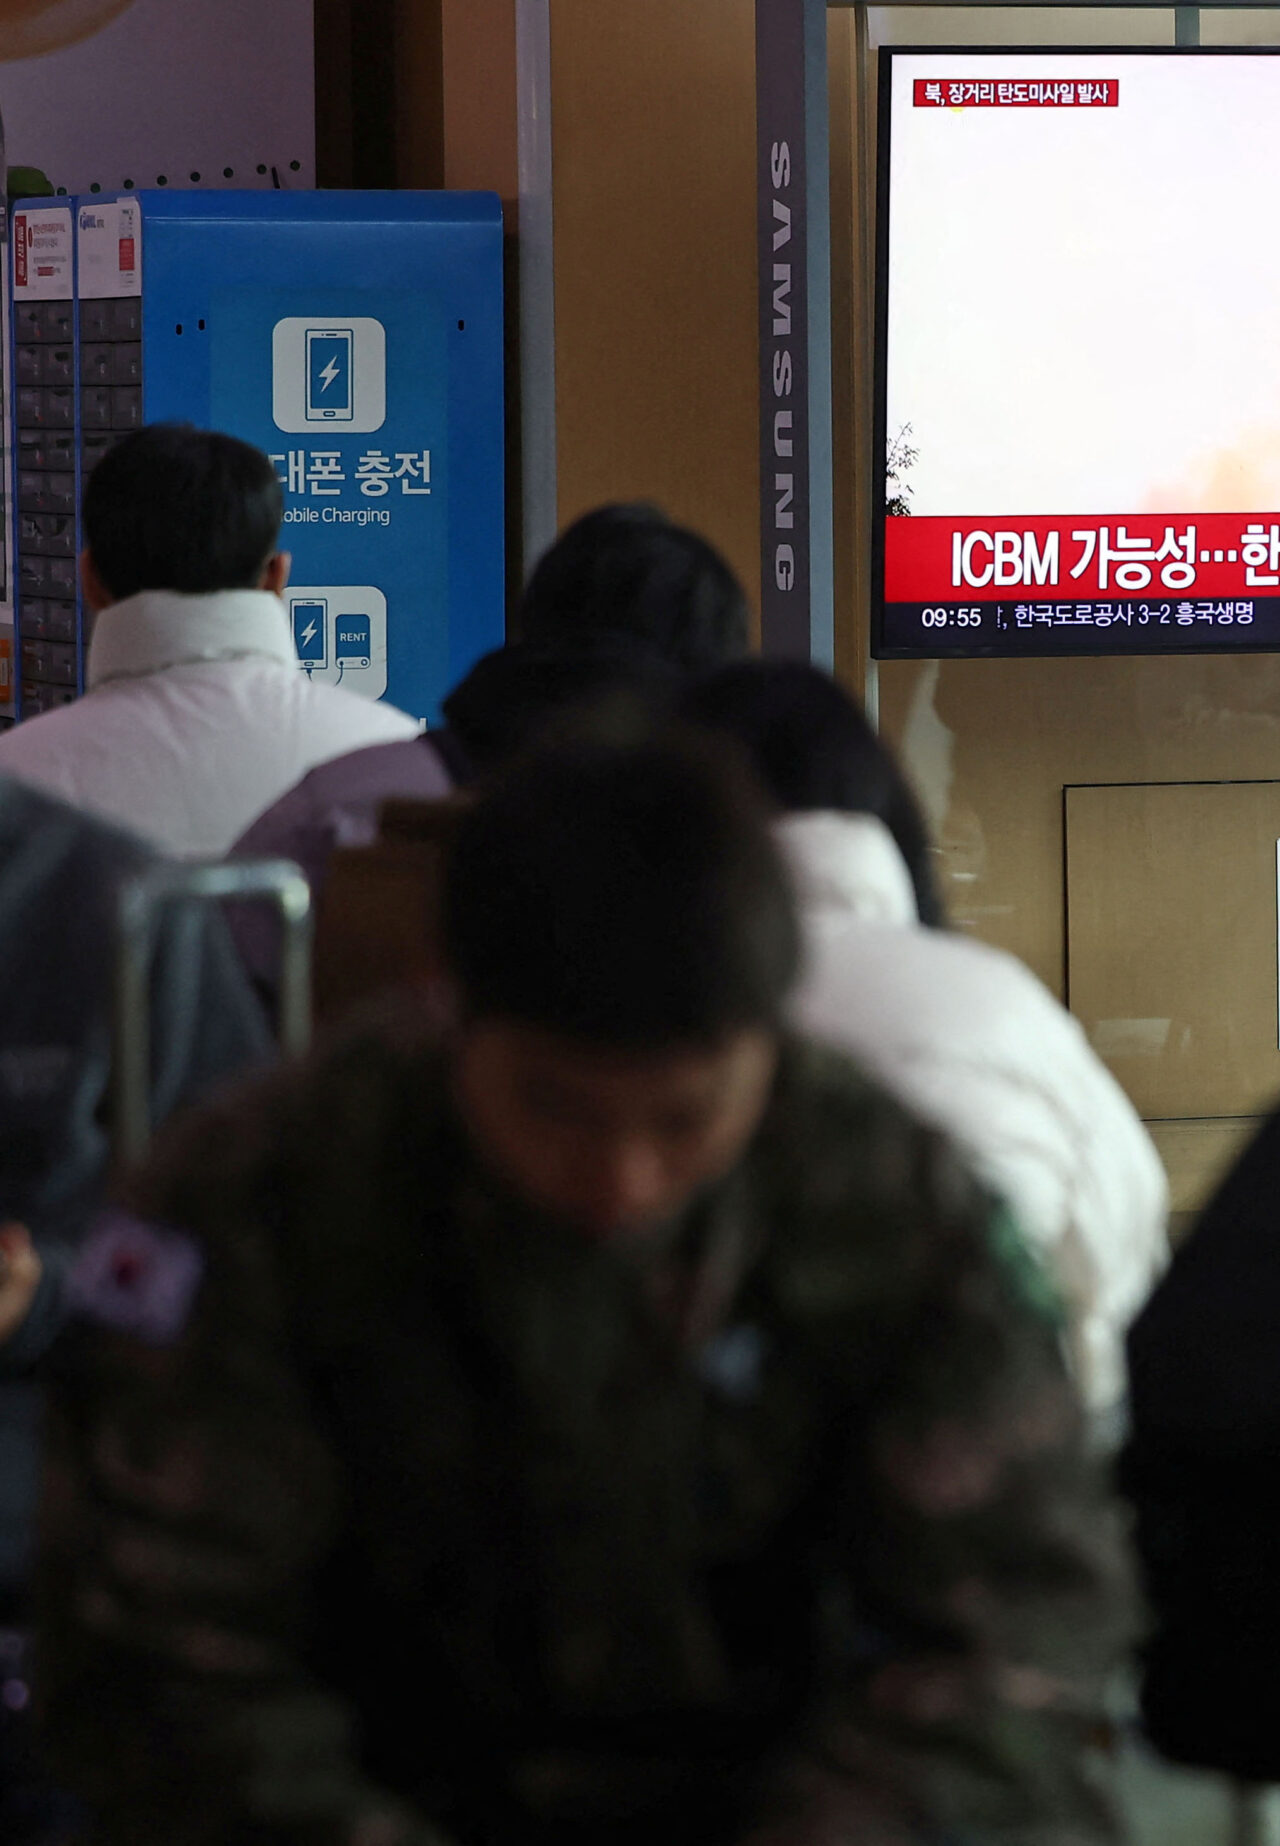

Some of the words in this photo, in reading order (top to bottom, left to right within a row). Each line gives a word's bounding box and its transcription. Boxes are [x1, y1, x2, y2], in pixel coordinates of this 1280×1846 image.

[924, 82, 946, 106] 북,
[948, 82, 994, 104] 장거리
[997, 82, 1074, 104] 탄도미사일
[1077, 82, 1109, 104] 발사
[770, 141, 795, 591] SAMSUNG
[268, 450, 345, 495] 대폰
[354, 450, 431, 497] 충전
[282, 507, 319, 523] obile
[321, 507, 390, 526] Charging
[952, 530, 1059, 588] ICBM
[922, 608, 982, 627] 09:55
[1014, 603, 1134, 627] 한국도로공사
[1138, 603, 1171, 625] 3-2
[1175, 601, 1254, 625] 흥국생명
[340, 632, 367, 642] RENT
